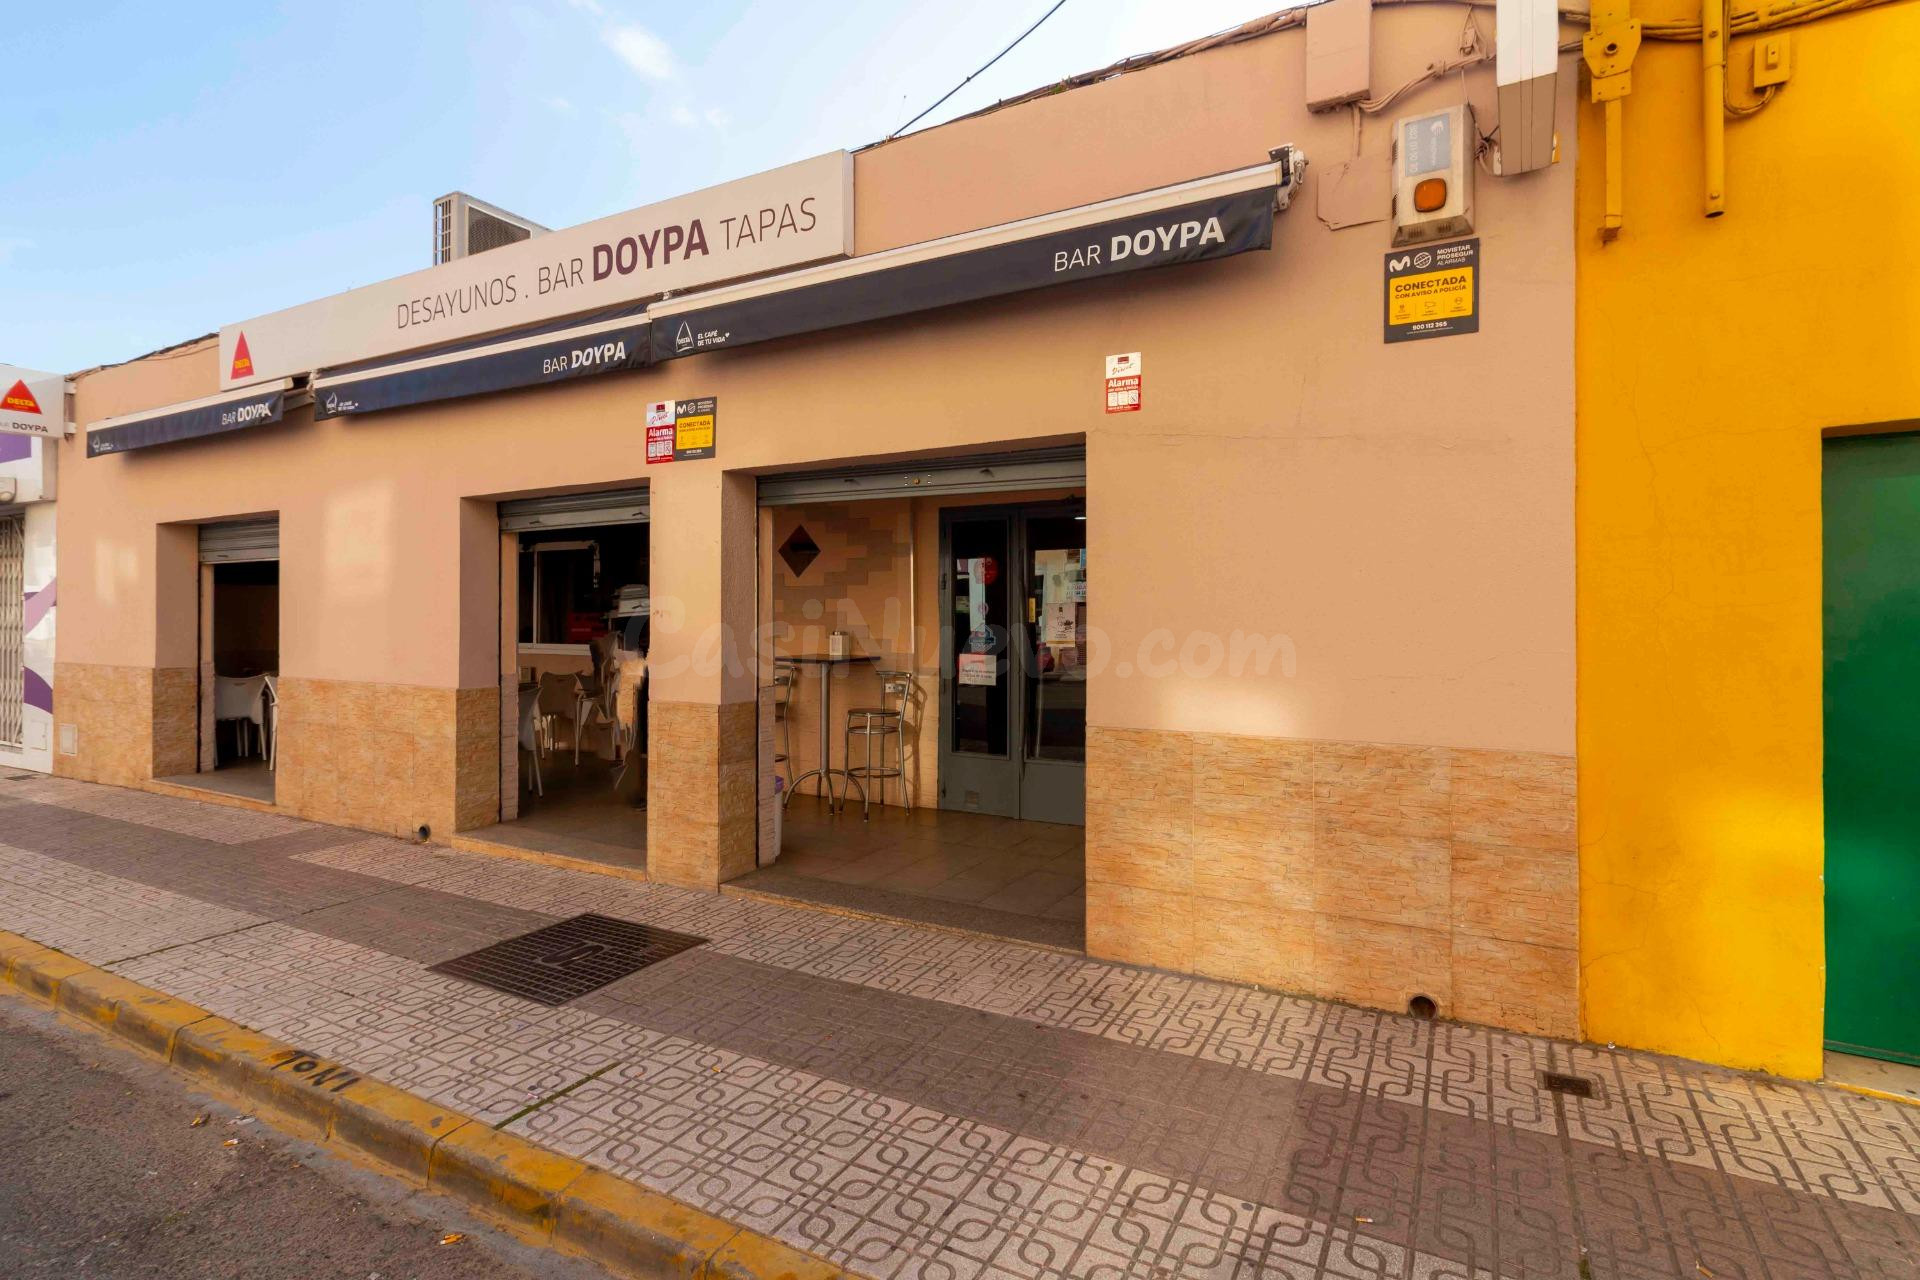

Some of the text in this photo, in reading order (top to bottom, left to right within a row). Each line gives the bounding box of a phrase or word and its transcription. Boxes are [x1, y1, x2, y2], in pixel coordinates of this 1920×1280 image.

[1054, 216, 1226, 273] BAR DOYPA
[1437, 245, 1471, 255] MOVISTAR
[1437, 250, 1473, 260] PROSEGUR
[397, 275, 517, 330] DESAYUNOS
[538, 257, 585, 295] BAR
[592, 218, 710, 282] DOYPA
[719, 197, 817, 250] TAPAS
[1394, 275, 1467, 293] CONECTADA
[1411, 289, 1432, 298] AVISO
[543, 341, 627, 374] BAR DOYPA
[1108, 378, 1139, 389] Alarma
[7, 396, 36, 407] DELTA
[221, 402, 272, 426] BAR DOYPA
[12, 422, 49, 433] DOYPA
[648, 428, 673, 437] Alarma
